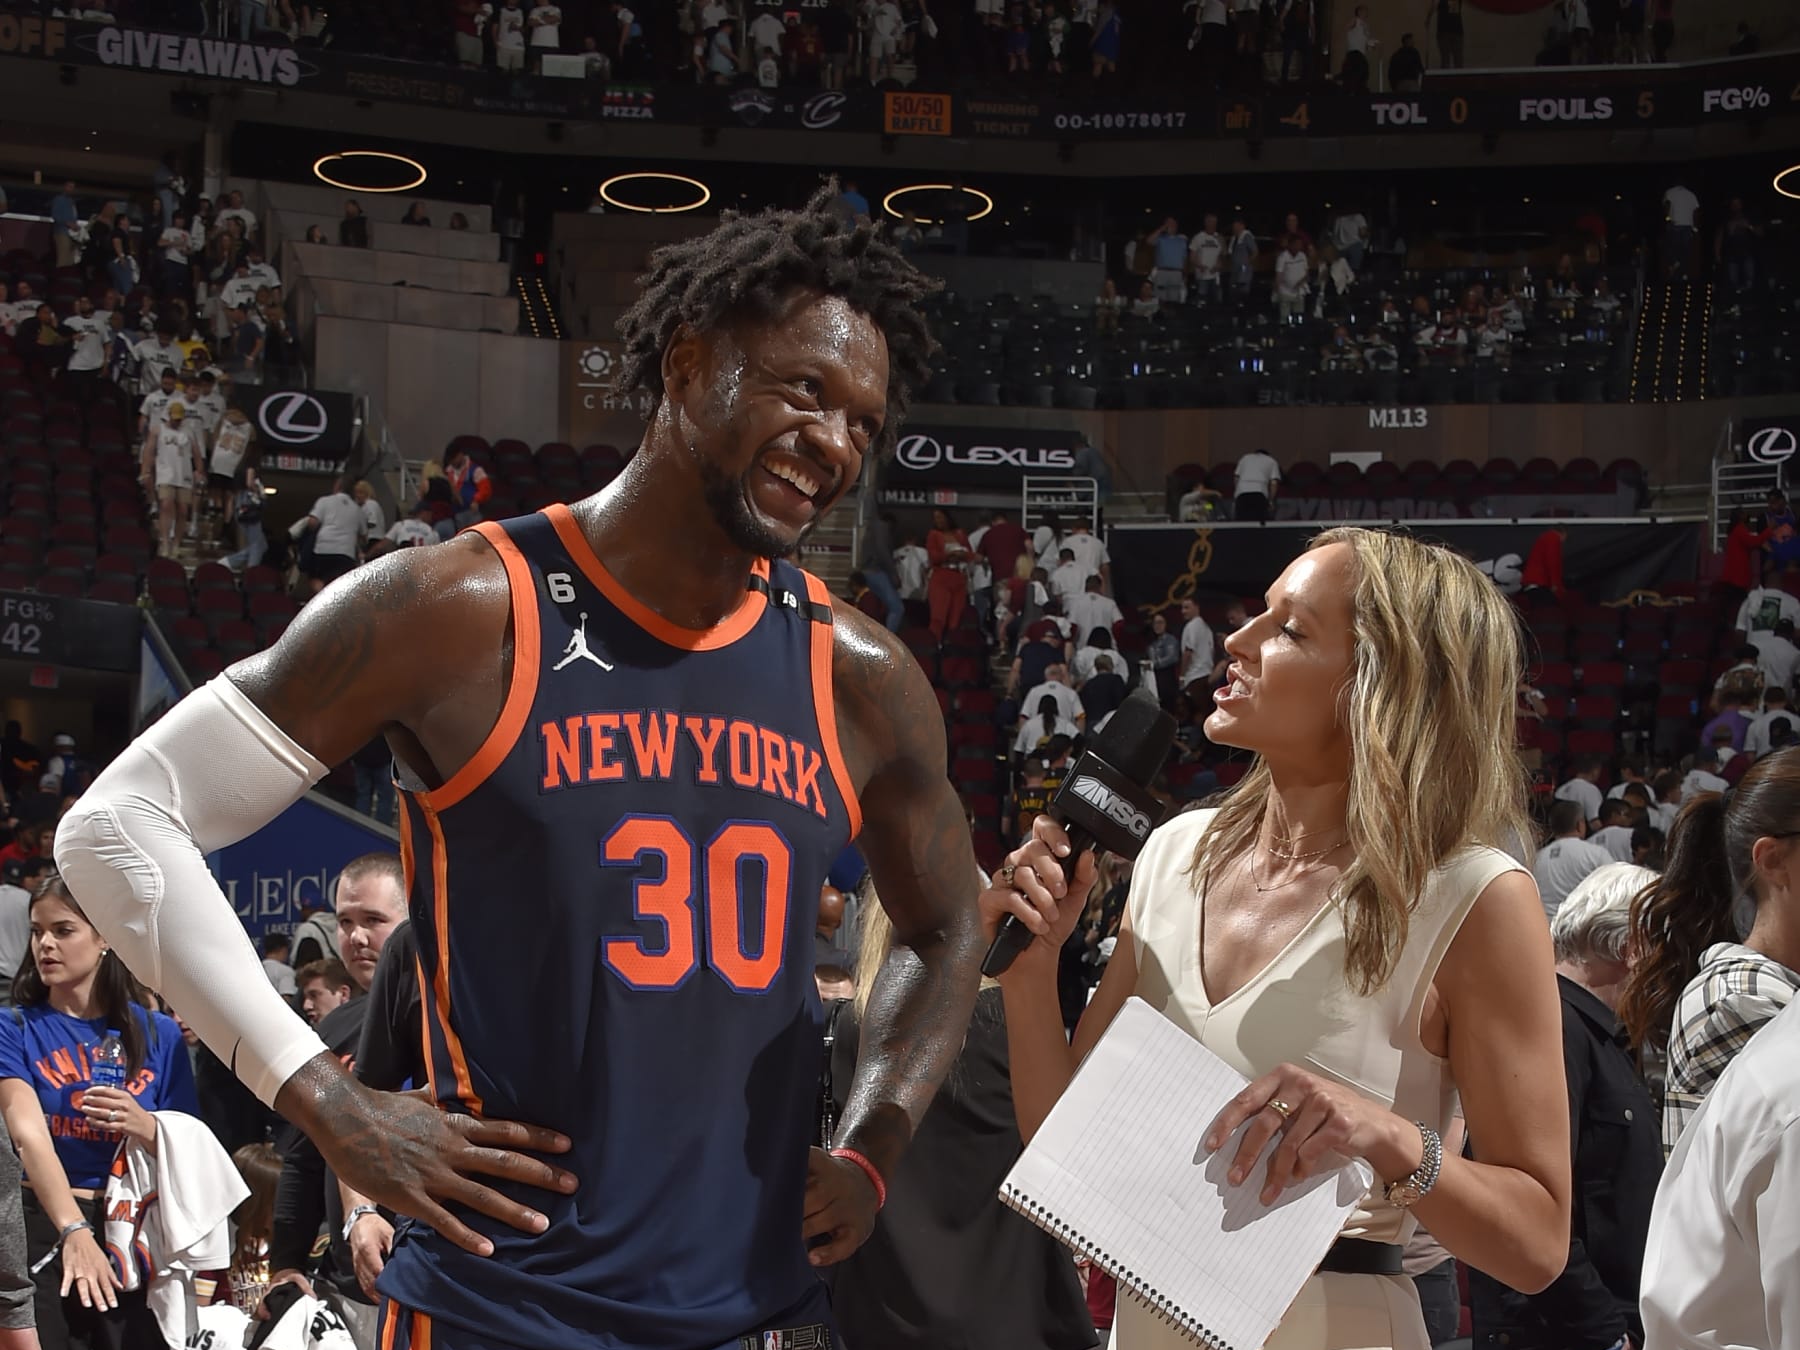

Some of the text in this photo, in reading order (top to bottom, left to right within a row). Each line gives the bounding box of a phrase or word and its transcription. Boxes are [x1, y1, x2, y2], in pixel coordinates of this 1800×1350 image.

[97, 26, 301, 87] GIVEAWAYS
[890, 96, 944, 116] 50/50
[966, 101, 1040, 117] WINNING
[1371, 97, 1468, 125] TOL 0
[1519, 90, 1656, 121] FOULS 5
[1702, 86, 1771, 112] FG%
[602, 105, 655, 119] PIZZA
[891, 116, 944, 131] RAFFLE
[973, 120, 1033, 135] TICKET
[1368, 407, 1429, 428] M113
[945, 445, 1076, 469] LEXUS
[547, 572, 576, 603] 6
[782, 590, 798, 608] 19
[3, 597, 55, 622] FG%
[1, 621, 41, 654] 42
[540, 709, 828, 819] NEW YORK
[1089, 784, 1151, 838] MSG
[600, 813, 794, 994] 30
